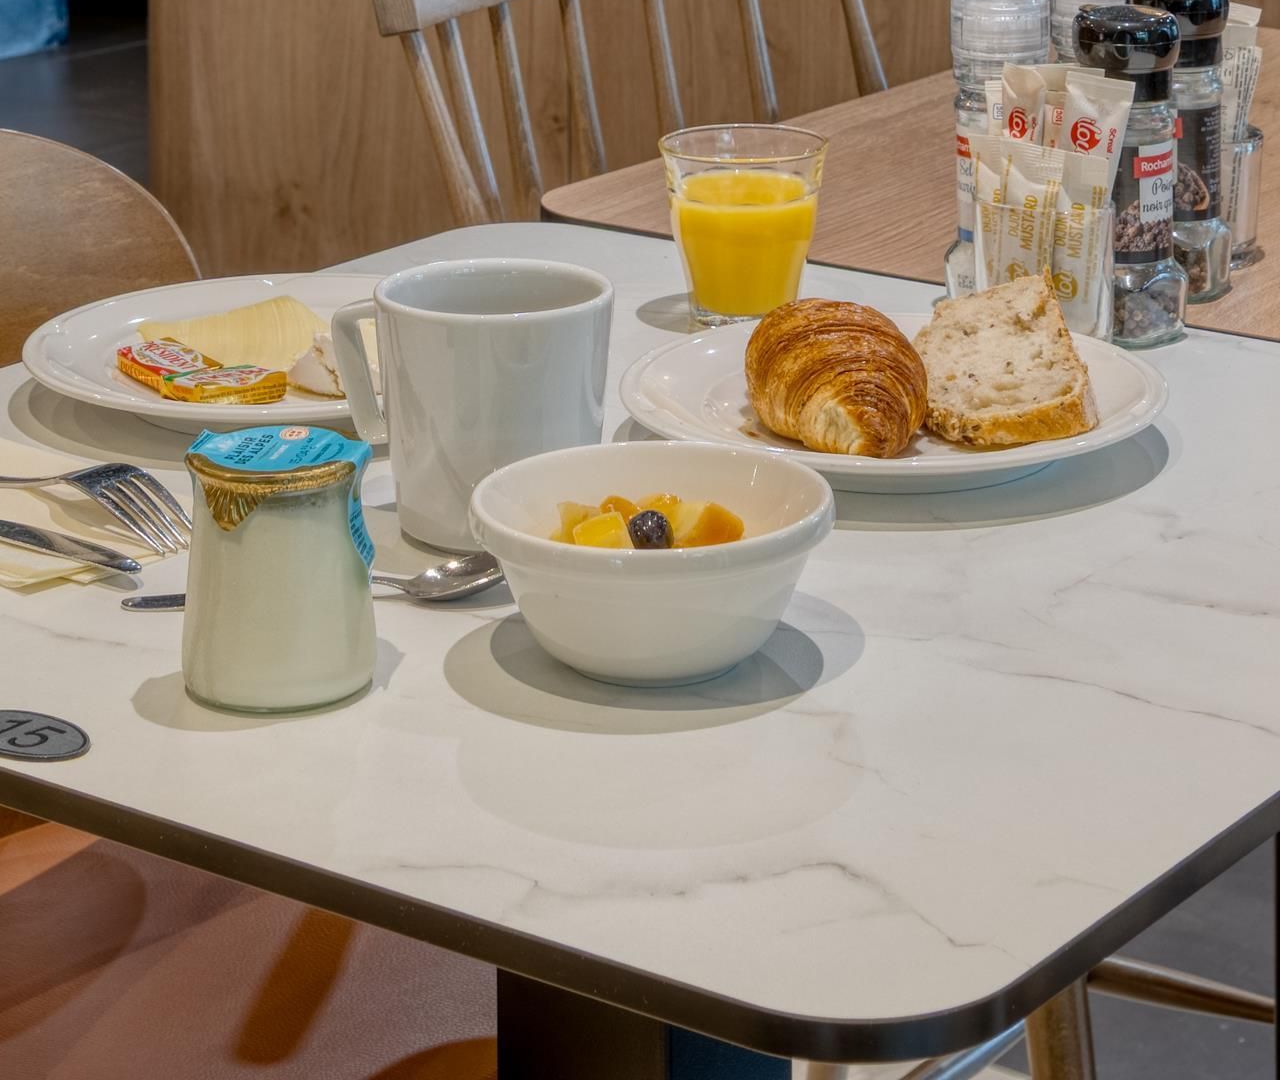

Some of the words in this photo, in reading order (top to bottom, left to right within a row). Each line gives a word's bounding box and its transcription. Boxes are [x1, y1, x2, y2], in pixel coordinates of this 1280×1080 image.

[1020, 194, 1038, 251] MUSTARD
[224, 436, 256, 460] PLAISIR
[233, 450, 252, 465] DES
[250, 434, 275, 458] ALPES
